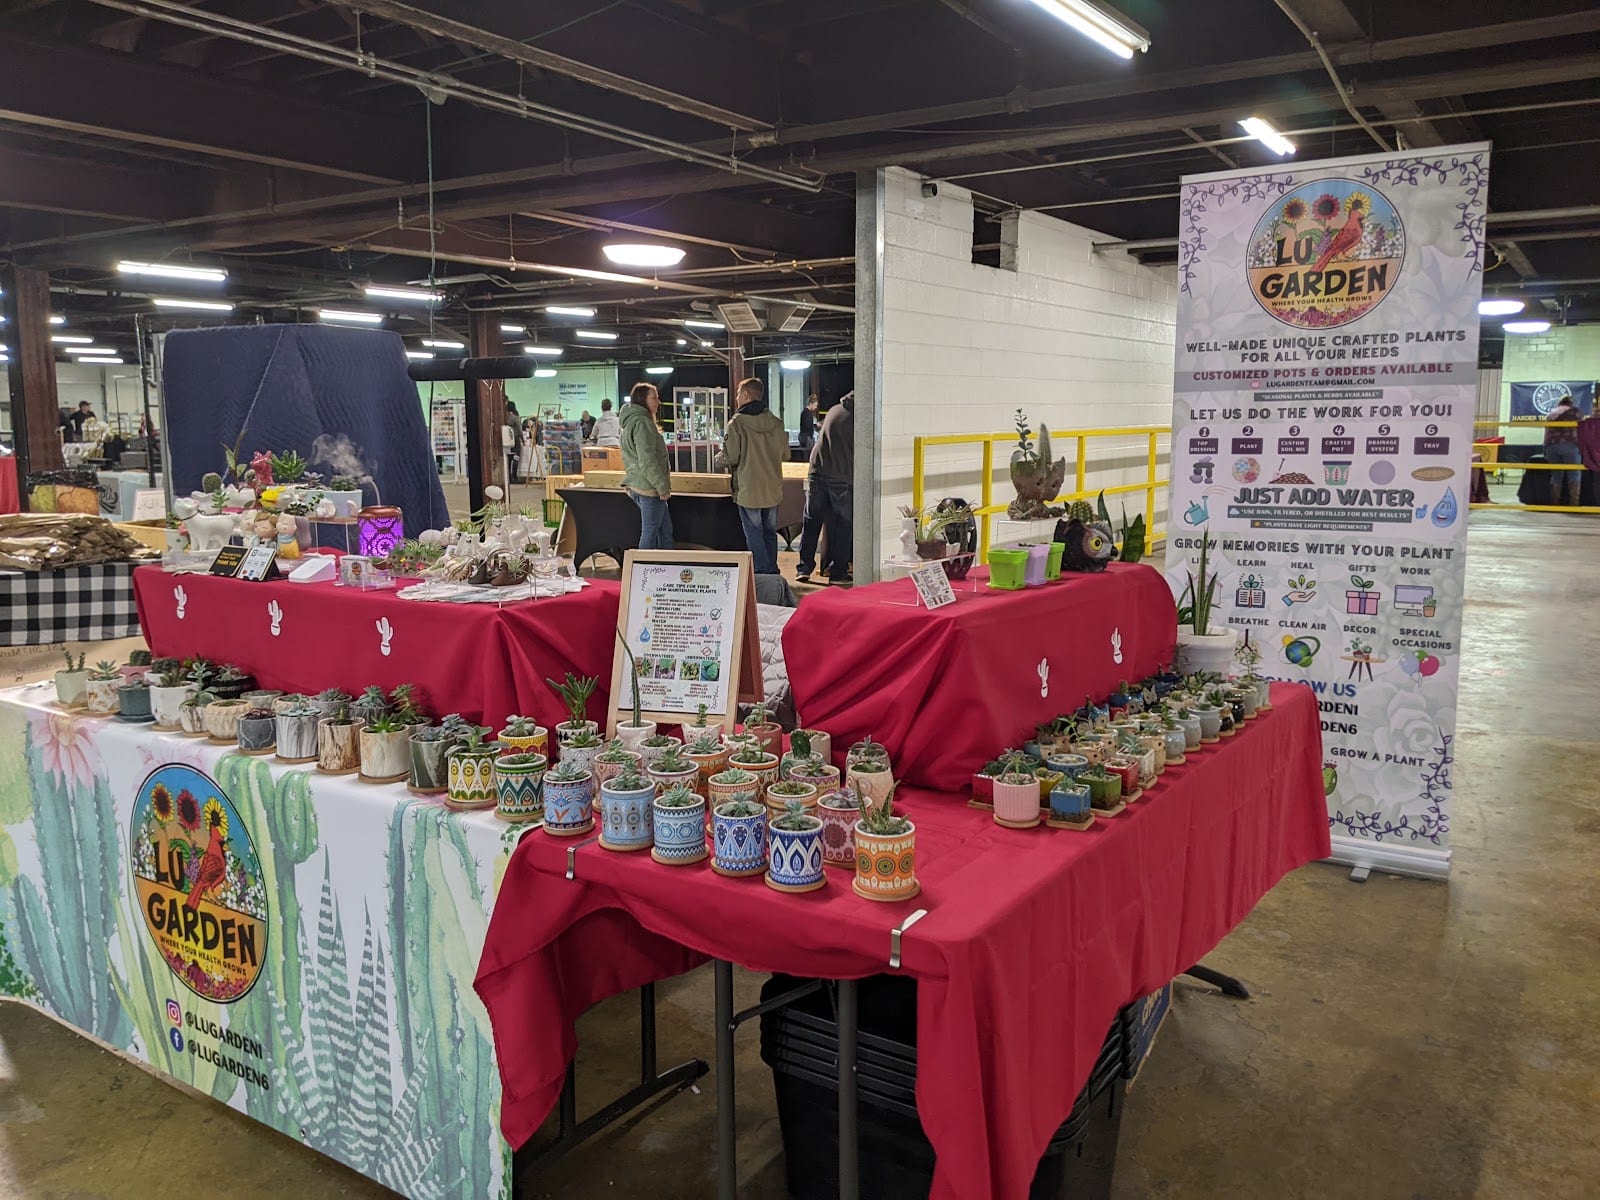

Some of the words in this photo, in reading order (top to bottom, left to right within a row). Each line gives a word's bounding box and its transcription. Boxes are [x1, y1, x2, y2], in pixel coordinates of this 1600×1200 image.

[1276, 236, 1313, 267] LU
[1260, 263, 1388, 299] GARDEN
[1297, 298, 1315, 306] YOUR
[1317, 296, 1344, 304] HEALTH
[1346, 295, 1372, 303] GROWS
[1187, 339, 1267, 353] WELL-MADE
[1273, 337, 1326, 350] UNIQUE
[1332, 333, 1399, 347] CRAFTED
[1406, 330, 1466, 343] PLANTS
[1241, 352, 1269, 363] FOR
[1275, 350, 1300, 361] ALL
[1306, 348, 1346, 360] YOUR
[1352, 347, 1399, 358] NEEDS
[1193, 369, 1269, 381] CUSTOMIZED
[1274, 367, 1306, 379] POTS
[1311, 367, 1319, 376] &
[1326, 365, 1376, 376] ORDERS
[1381, 363, 1453, 374] AVAILABLE
[1190, 408, 1216, 421] LET
[1222, 408, 1241, 419] US
[1248, 407, 1271, 420] DO
[1277, 407, 1307, 419] THE
[1314, 406, 1363, 418] WORK
[1370, 405, 1402, 417] FOR
[1410, 404, 1452, 417] YOU!
[1233, 487, 1284, 505] JUST
[1289, 488, 1330, 506] ADD
[1336, 489, 1415, 507] WATER
[1174, 538, 1217, 550] GROW
[1222, 539, 1300, 552] MEMORIES
[1306, 542, 1345, 555] WITH
[1352, 544, 1395, 557] YOUR
[1400, 547, 1454, 560] PLANT
[1191, 557, 1210, 565] LIE
[1237, 559, 1266, 567] LEARN
[1291, 562, 1314, 570] HEAL
[1349, 564, 1376, 573] GIFTS
[1400, 566, 1431, 575] WORK
[1228, 617, 1270, 626] BREATHE
[1278, 620, 1308, 630] CLEAN
[1310, 622, 1327, 631] AIR
[1343, 625, 1377, 635] DECOR
[1399, 628, 1442, 638] SPECIAL
[1392, 638, 1452, 650] OCCASIONS
[1333, 682, 1357, 697] US
[1317, 700, 1358, 715] RDEN1
[1319, 720, 1357, 734] DEN6
[1330, 747, 1368, 760] GROW
[1372, 751, 1380, 761] A
[1385, 753, 1425, 767] PLANT
[153, 840, 185, 892] LU
[147, 892, 258, 967] GARDEN
[159, 934, 179, 950] WHERE
[179, 942, 197, 958] YOUR
[198, 950, 222, 967] HEALTH
[222, 960, 247, 976] GROWS
[188, 1039, 270, 1090] @LUGARDEN6
